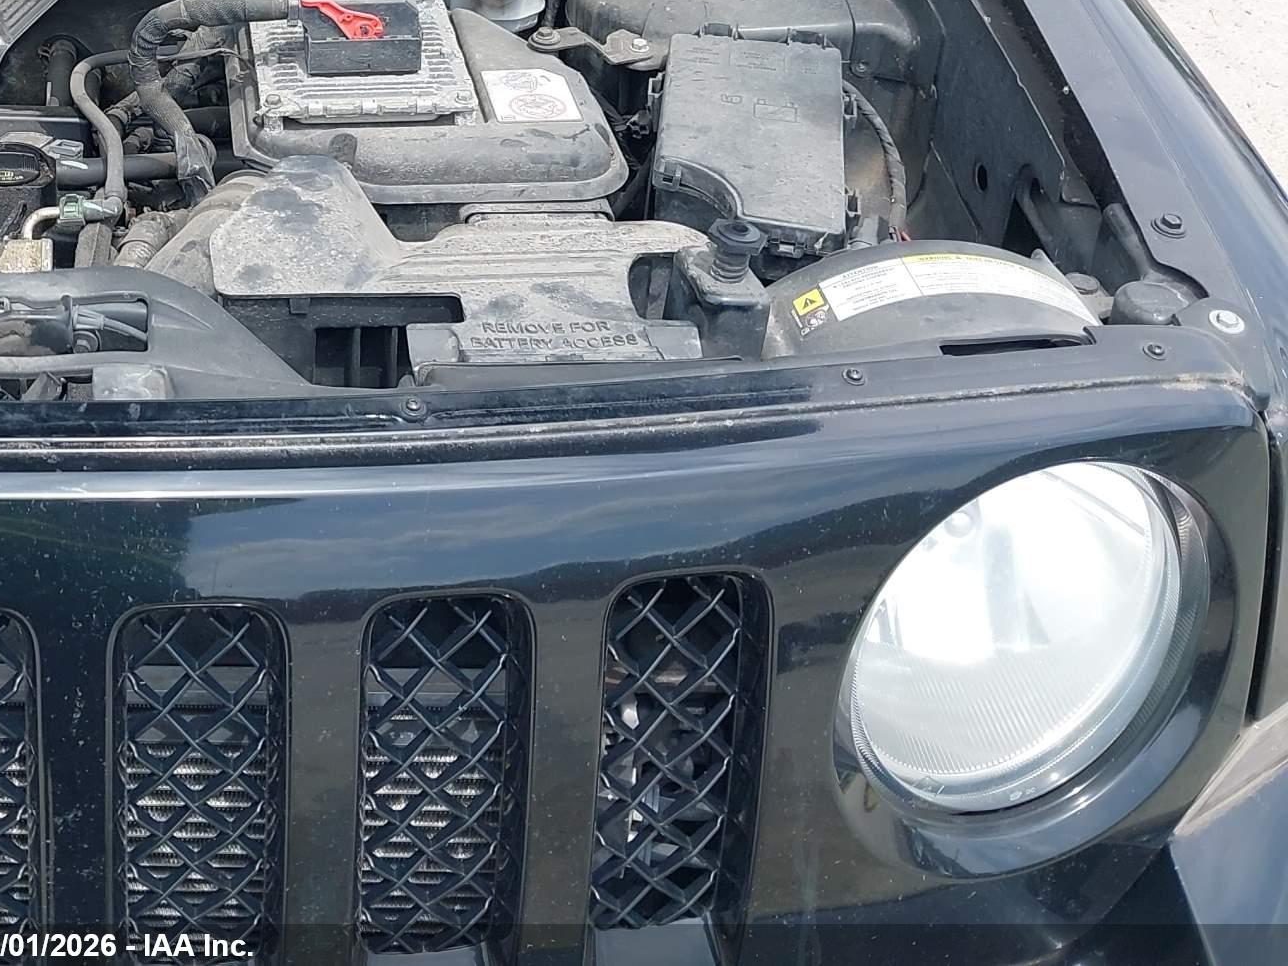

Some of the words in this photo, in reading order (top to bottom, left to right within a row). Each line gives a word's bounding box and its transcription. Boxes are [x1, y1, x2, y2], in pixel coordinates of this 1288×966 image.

[481, 321, 565, 334] REMOVE
[569, 321, 611, 333] FOR
[470, 336, 554, 349] BATTERY
[561, 334, 640, 348] ACCESS
